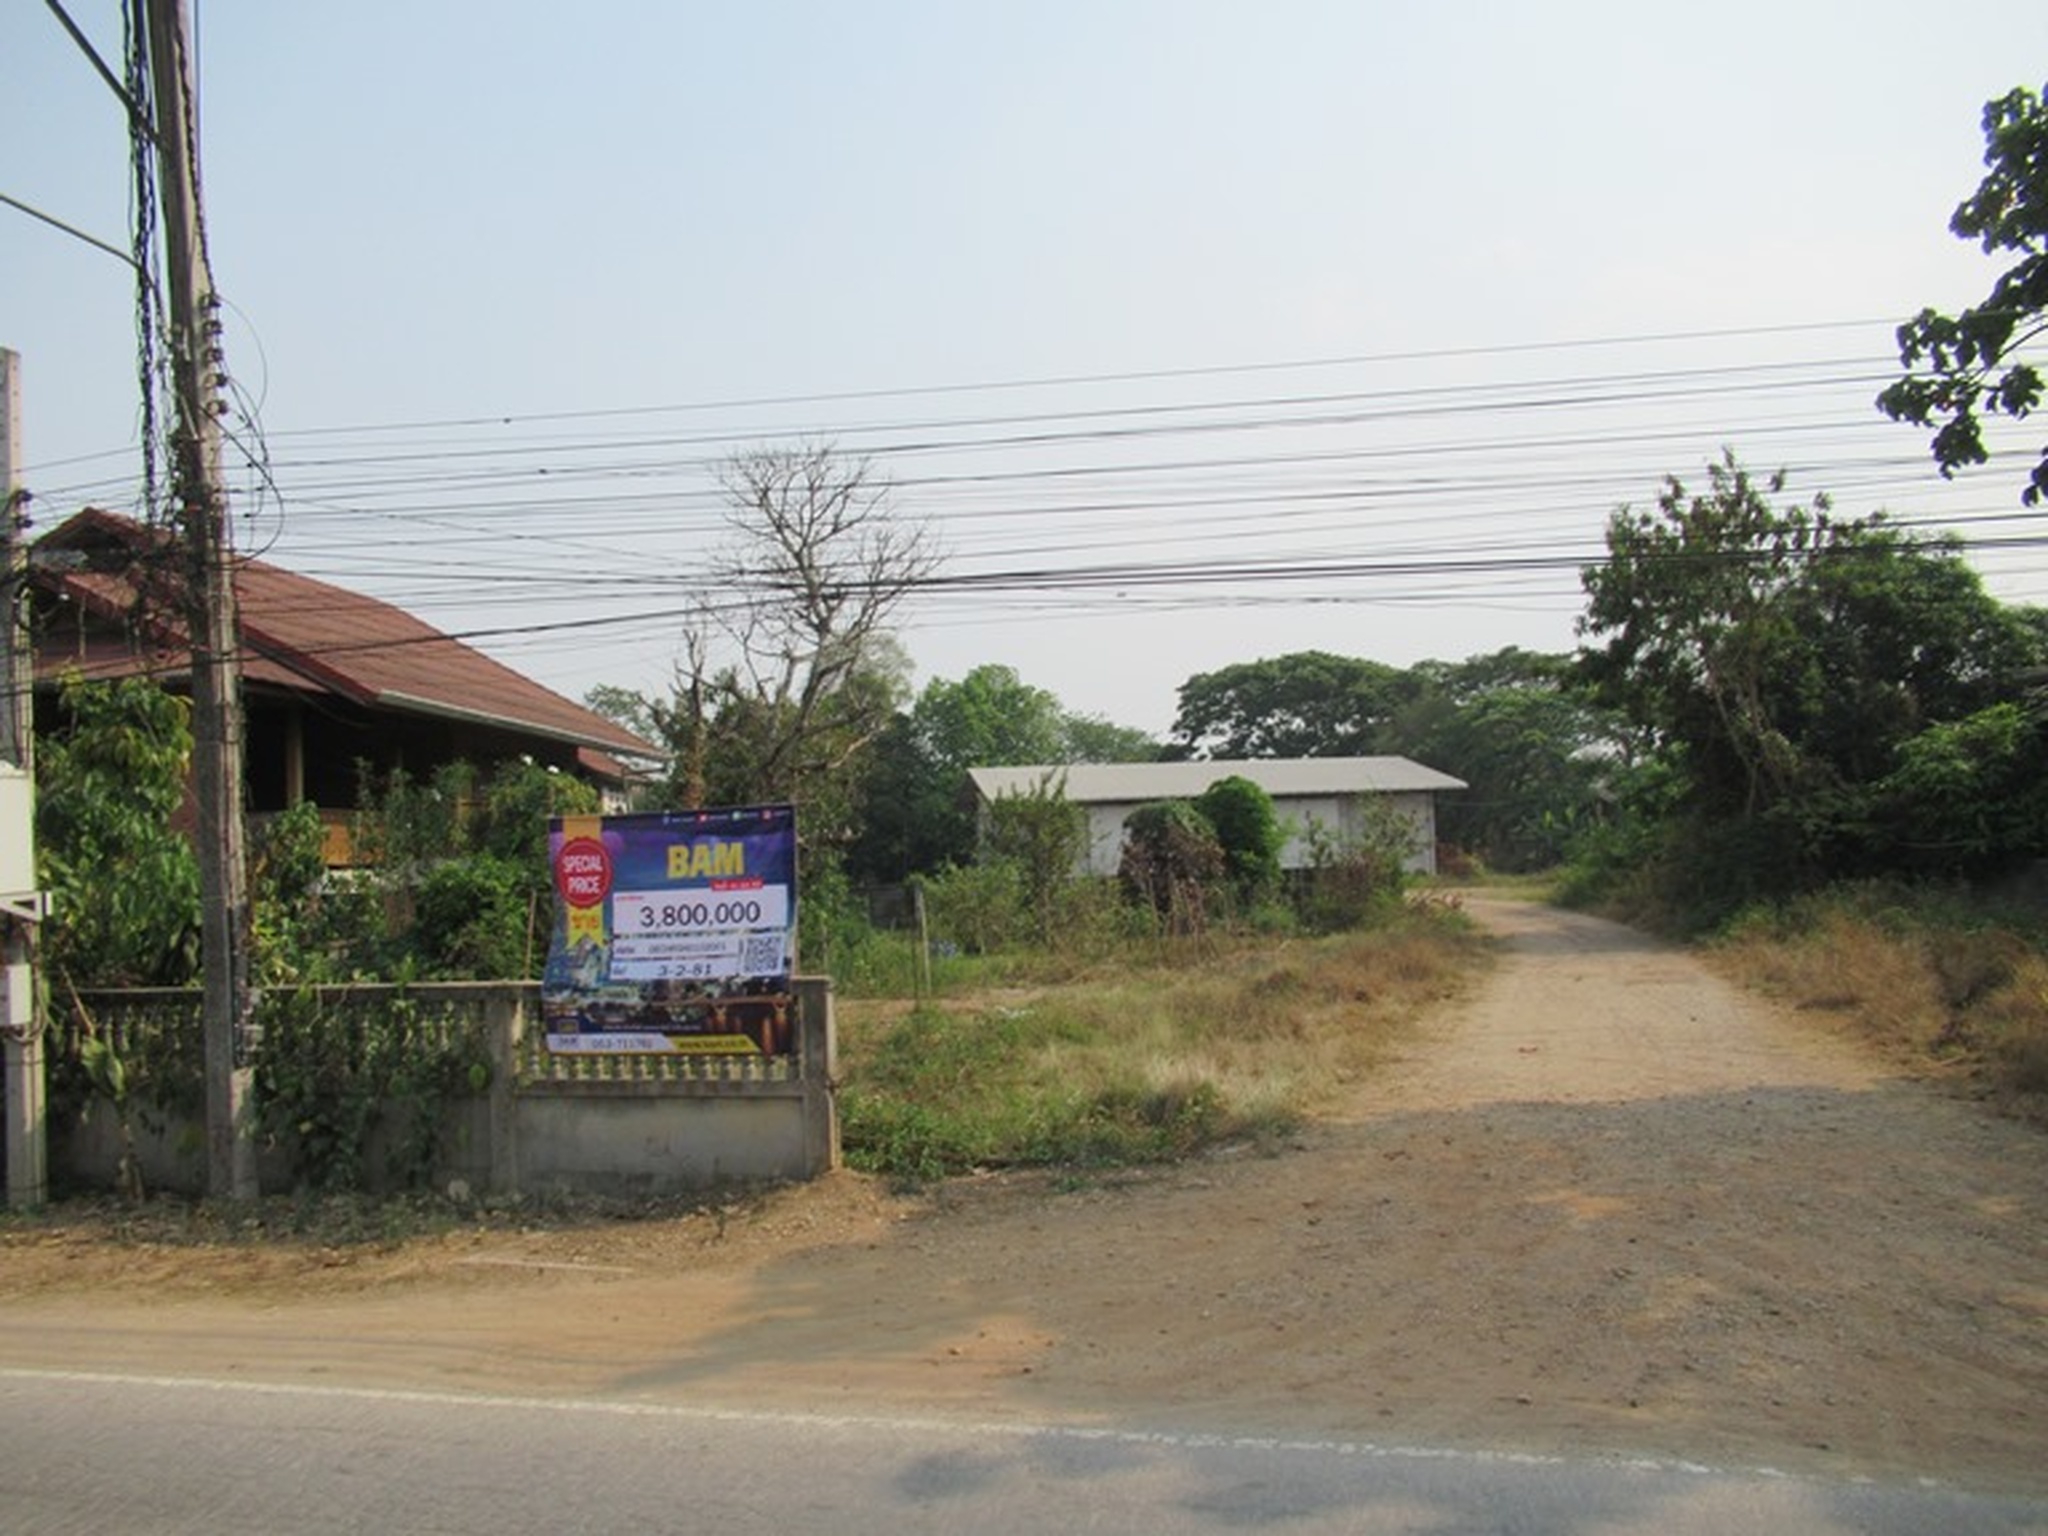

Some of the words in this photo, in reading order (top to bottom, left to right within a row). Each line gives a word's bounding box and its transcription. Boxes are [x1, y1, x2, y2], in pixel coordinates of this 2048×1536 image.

[562, 855, 603, 874] SPECIAL
[667, 842, 744, 879] BAM
[567, 876, 600, 895] PRICE
[640, 901, 761, 929] 3,800,000
